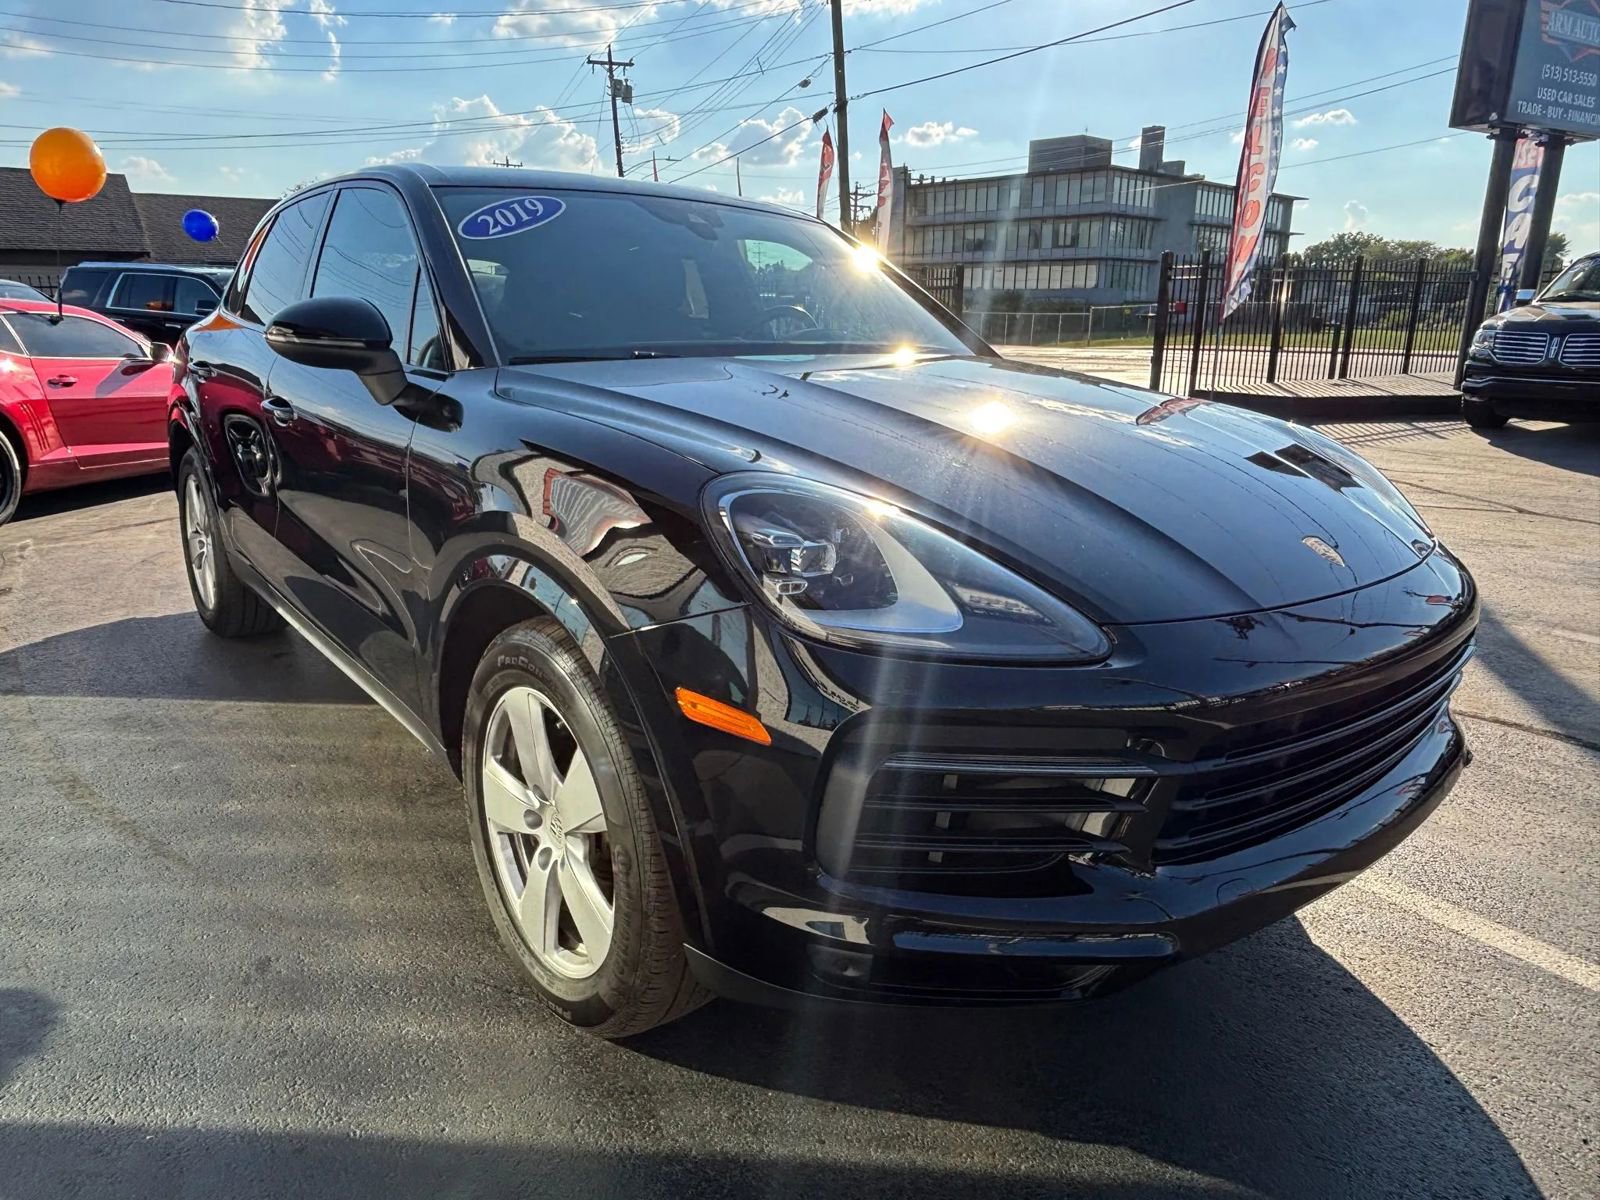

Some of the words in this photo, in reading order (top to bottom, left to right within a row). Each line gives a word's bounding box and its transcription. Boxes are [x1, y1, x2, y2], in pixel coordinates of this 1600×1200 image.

[1541, 64, 1562, 83] (513)
[1537, 87, 1557, 102] USED
[1557, 90, 1573, 105] CAR
[1573, 94, 1596, 108] SALES
[1517, 100, 1542, 116] TRADE
[1547, 106, 1564, 119] BUY
[477, 198, 544, 235] 2019
